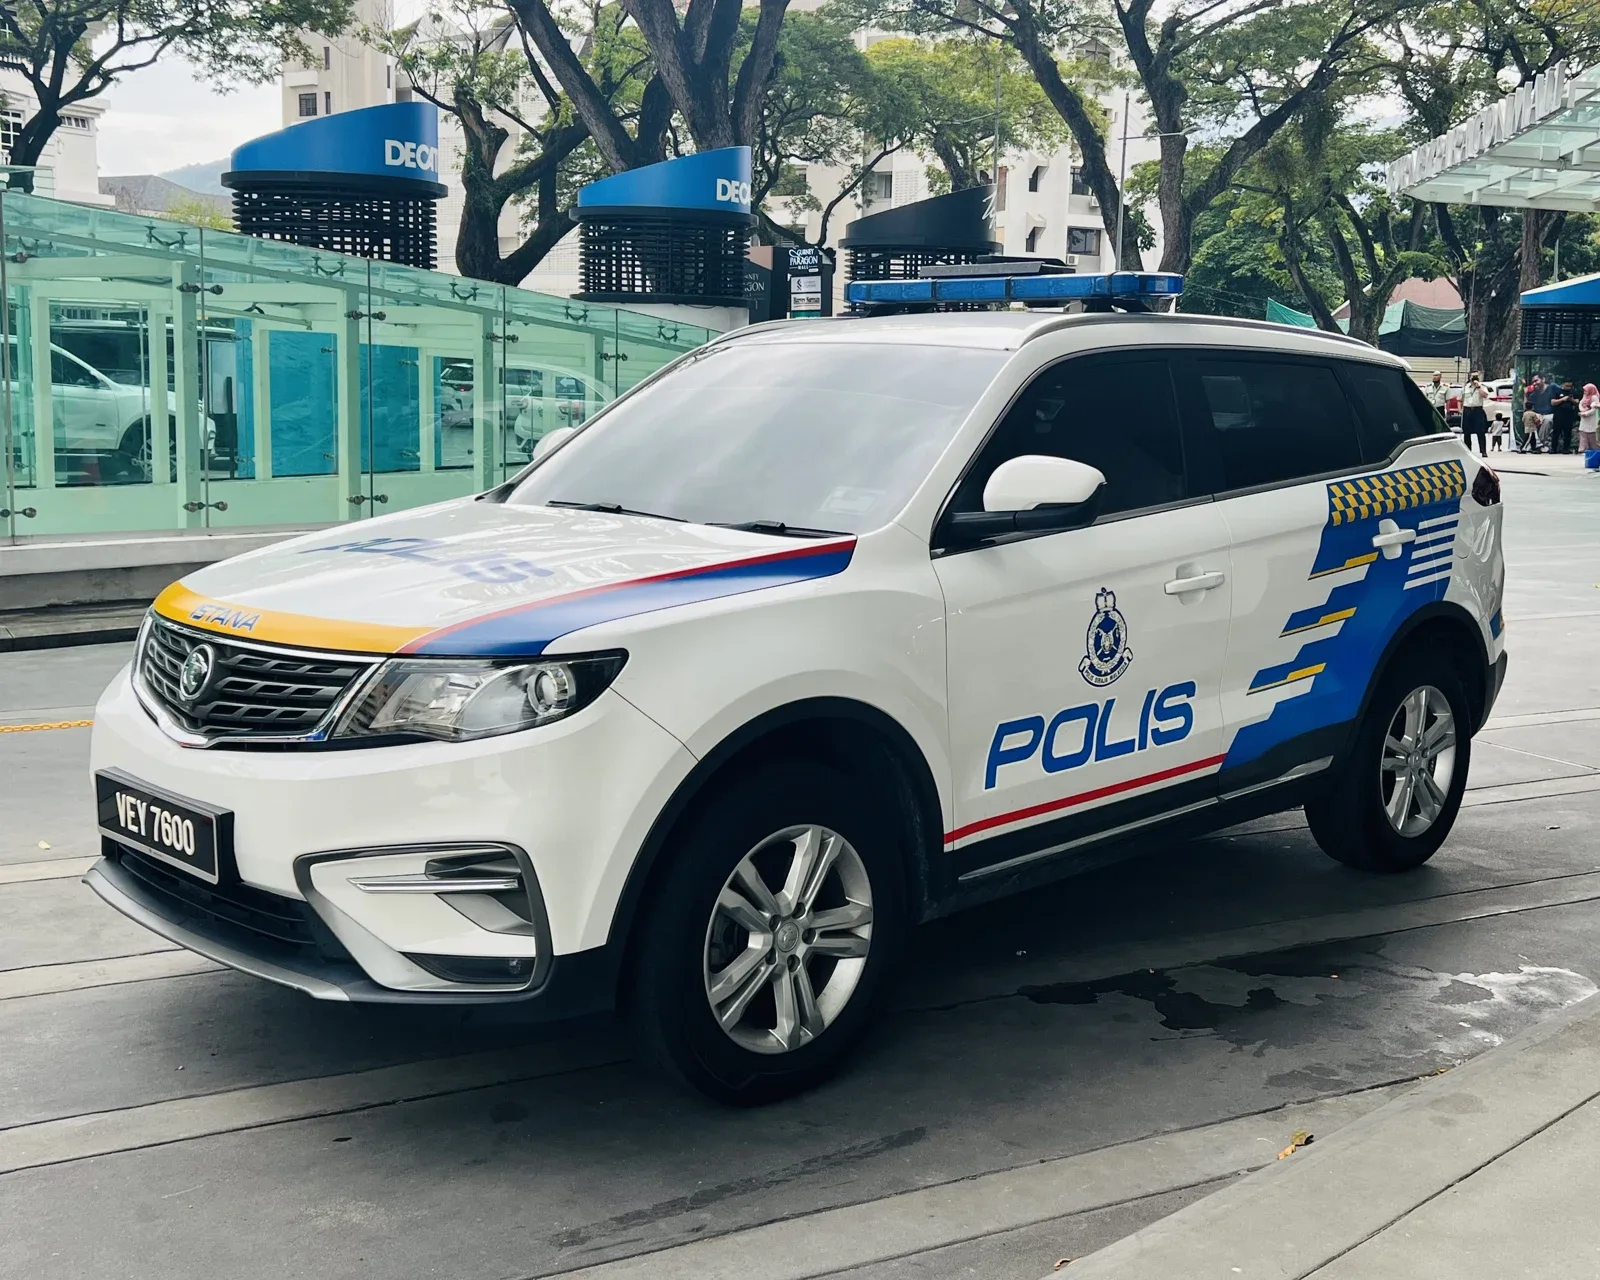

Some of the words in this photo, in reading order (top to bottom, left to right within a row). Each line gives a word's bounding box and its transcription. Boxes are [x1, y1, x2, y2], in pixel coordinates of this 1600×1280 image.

[190, 604, 261, 632] ISTANA
[984, 680, 1197, 791] POLIS
[115, 791, 148, 837] VEY
[149, 805, 196, 856] 7600
